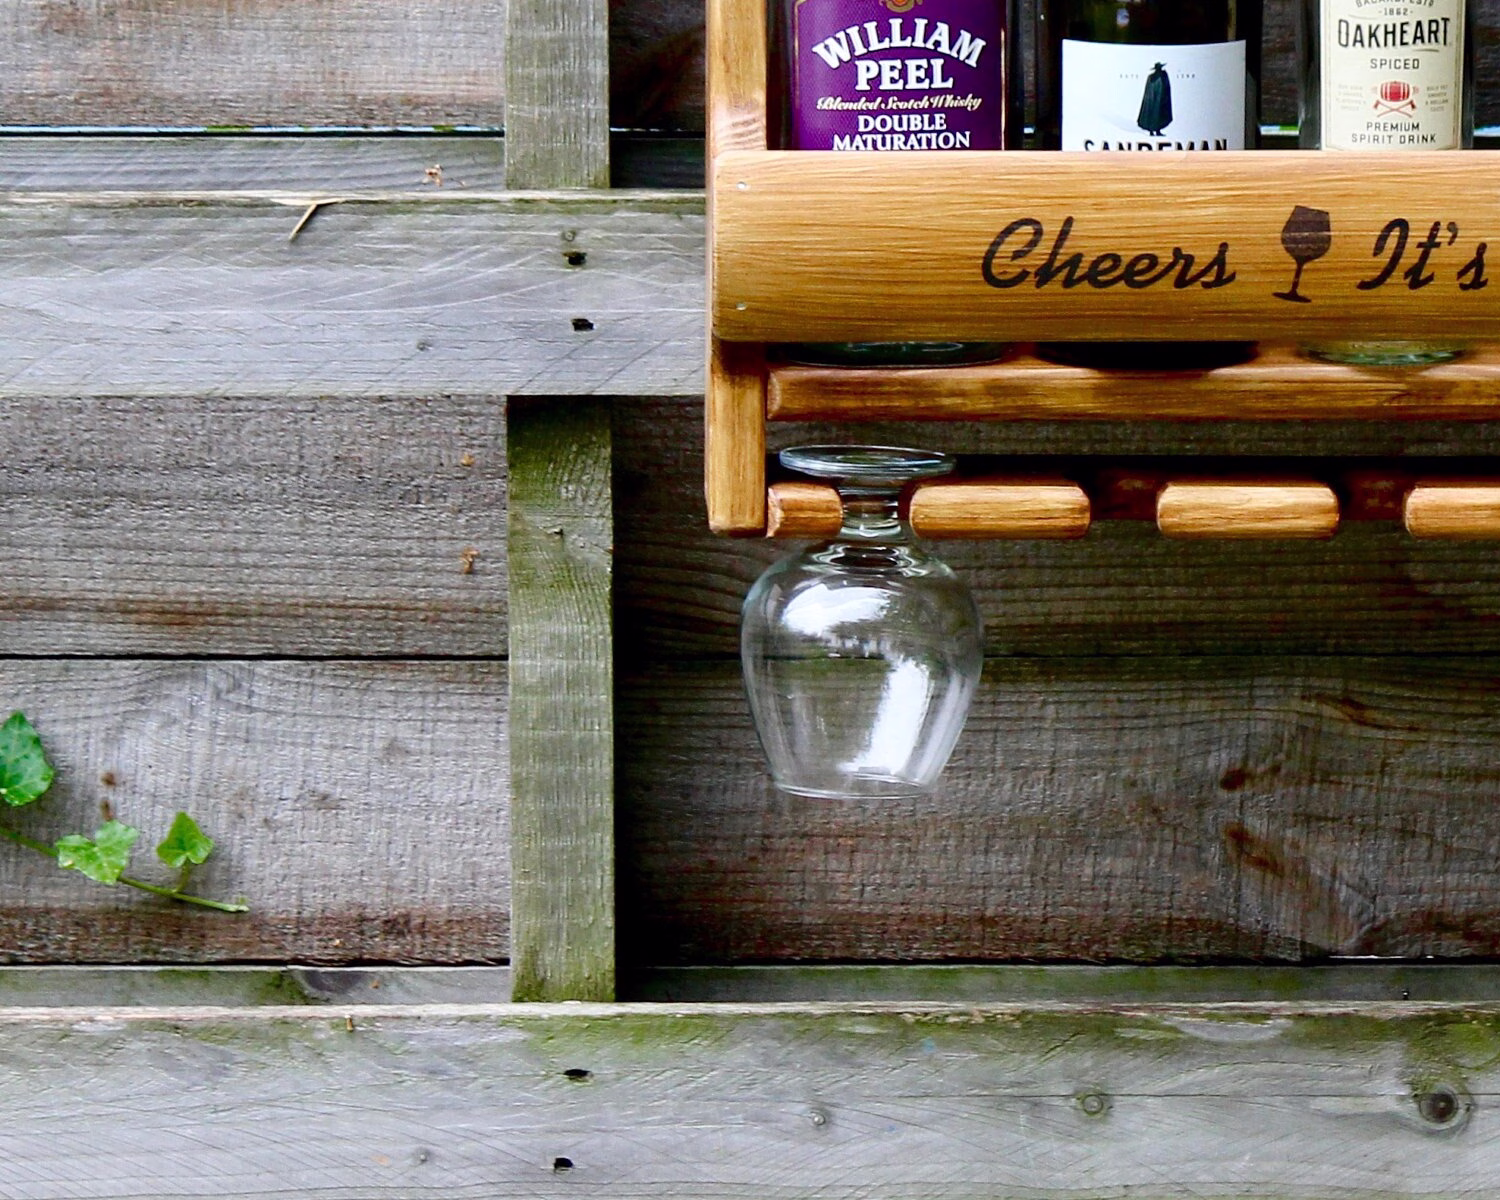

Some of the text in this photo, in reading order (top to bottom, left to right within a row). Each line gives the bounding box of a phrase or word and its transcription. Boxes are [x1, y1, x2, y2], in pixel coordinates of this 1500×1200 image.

[1338, 17, 1451, 48] OAKHEART
[811, 18, 987, 70] WILLIAM
[1370, 58, 1420, 70] SPICED
[855, 58, 954, 91] PEEL
[816, 93, 983, 112] Blended Scotch Whisky
[857, 113, 947, 133] DOUBLE
[1366, 121, 1420, 132] PREMIUM
[832, 130, 971, 150] MATURATION
[1351, 133, 1437, 144] SPIRIT DRINK
[980, 214, 1237, 290] Cheers
[1356, 216, 1490, 291] It's
